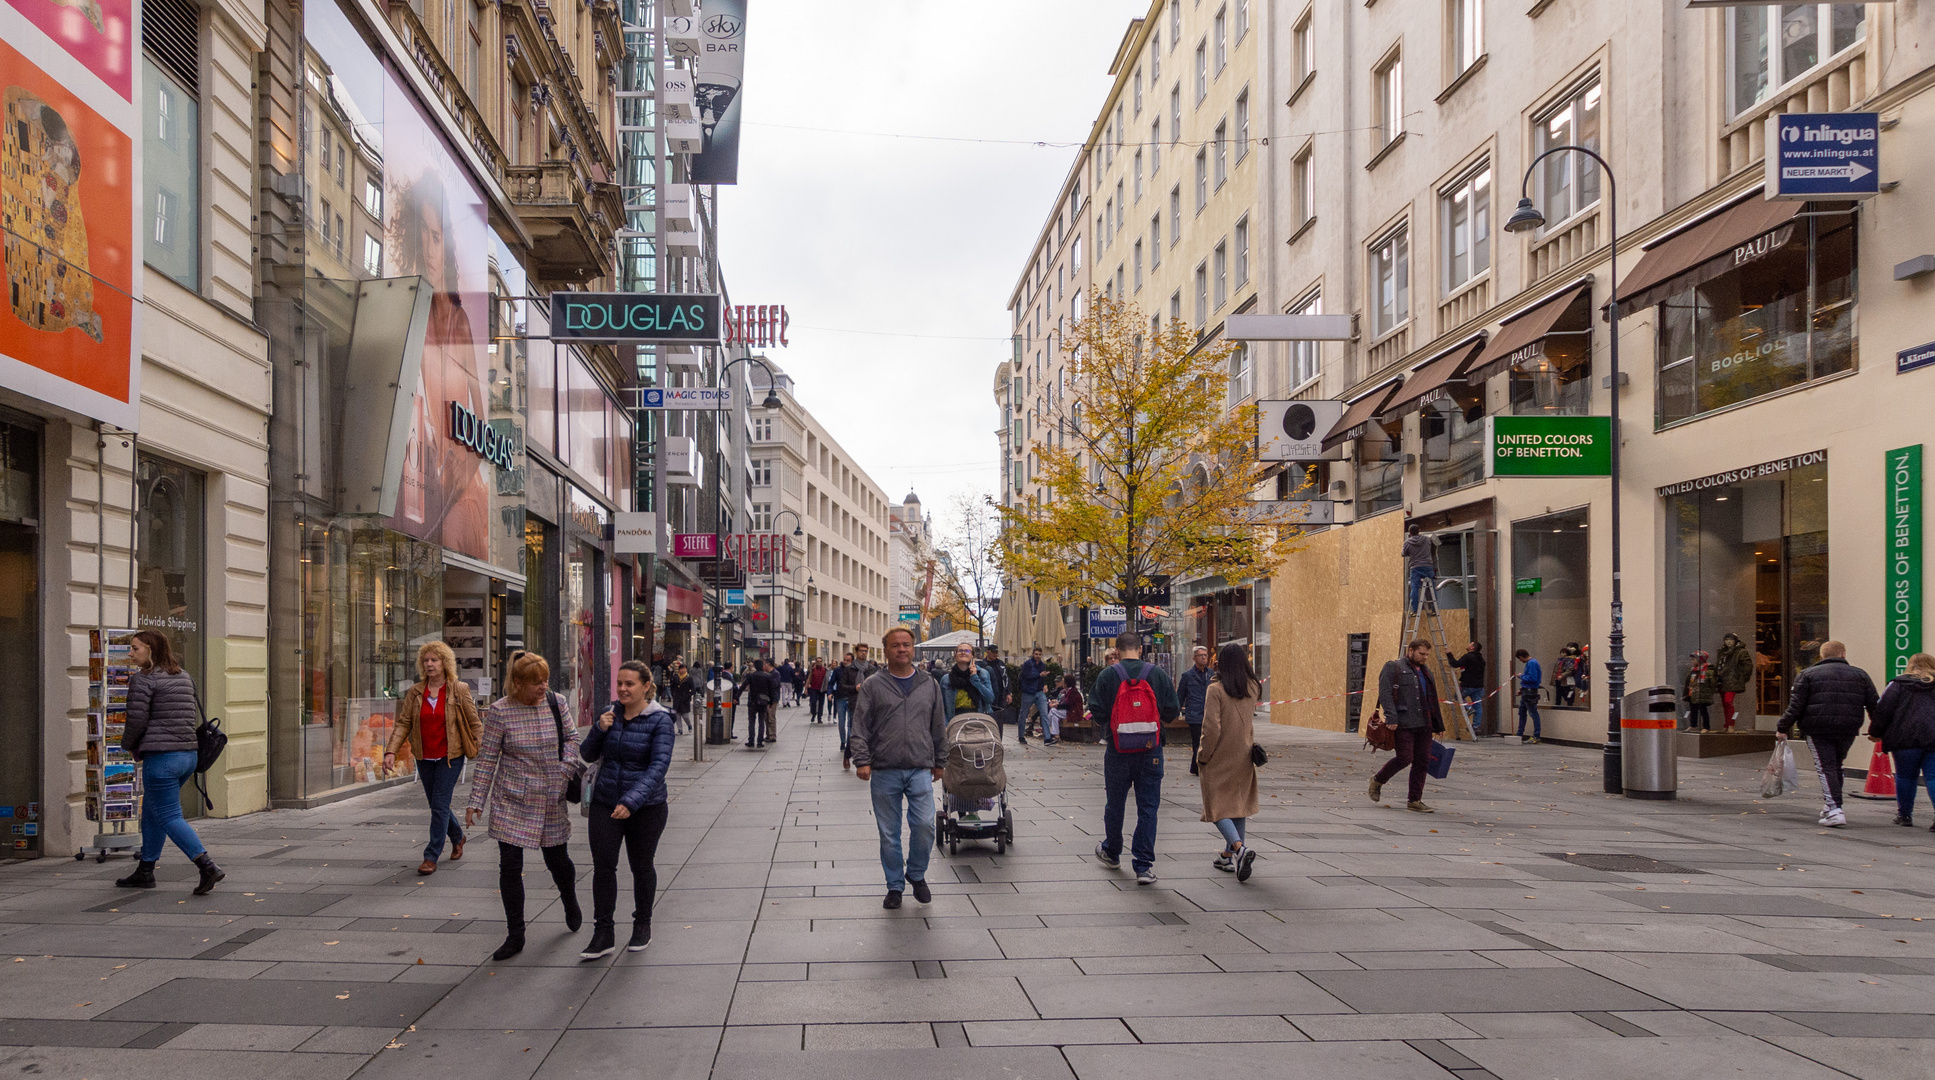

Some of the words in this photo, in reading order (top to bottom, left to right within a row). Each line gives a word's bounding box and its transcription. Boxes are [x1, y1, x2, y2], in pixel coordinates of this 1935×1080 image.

[707, 15, 741, 39] sky
[707, 44, 738, 52] BAR
[665, 81, 686, 90] OSS
[1804, 124, 1875, 145] inlingua
[1783, 148, 1874, 159] www.inlingua.at
[1818, 168, 1848, 176] MARKT
[1734, 230, 1781, 266] PAUL
[566, 304, 705, 331] DOUGLAS
[724, 305, 789, 345] STEFFL
[1510, 343, 1539, 366] PAUL
[665, 390, 697, 400] MAGIC
[700, 390, 730, 400] TOURS
[1420, 389, 1441, 407] PAUL
[451, 400, 514, 472] DOUGLAS
[1346, 424, 1364, 440] PAUL
[1497, 434, 1542, 445] UNITED
[1544, 434, 1593, 445] COLORS
[1497, 447, 1514, 457] OF
[1516, 447, 1583, 457] BENETTON.
[1658, 480, 1694, 497] UNITED
[1695, 470, 1738, 490] COLORS
[1740, 466, 1758, 480] OF
[1758, 451, 1828, 476] BENETTON.
[1895, 452, 1910, 548] BENETTON.
[724, 534, 790, 573] STEFFL
[1895, 552, 1910, 576] OF
[1138, 587, 1165, 595] nes
[1103, 607, 1126, 615] TISS
[1895, 579, 1910, 651] COLORS
[138, 613, 166, 627] rldwide
[167, 616, 197, 632] Shipping
[1090, 625, 1117, 635] CHANGE
